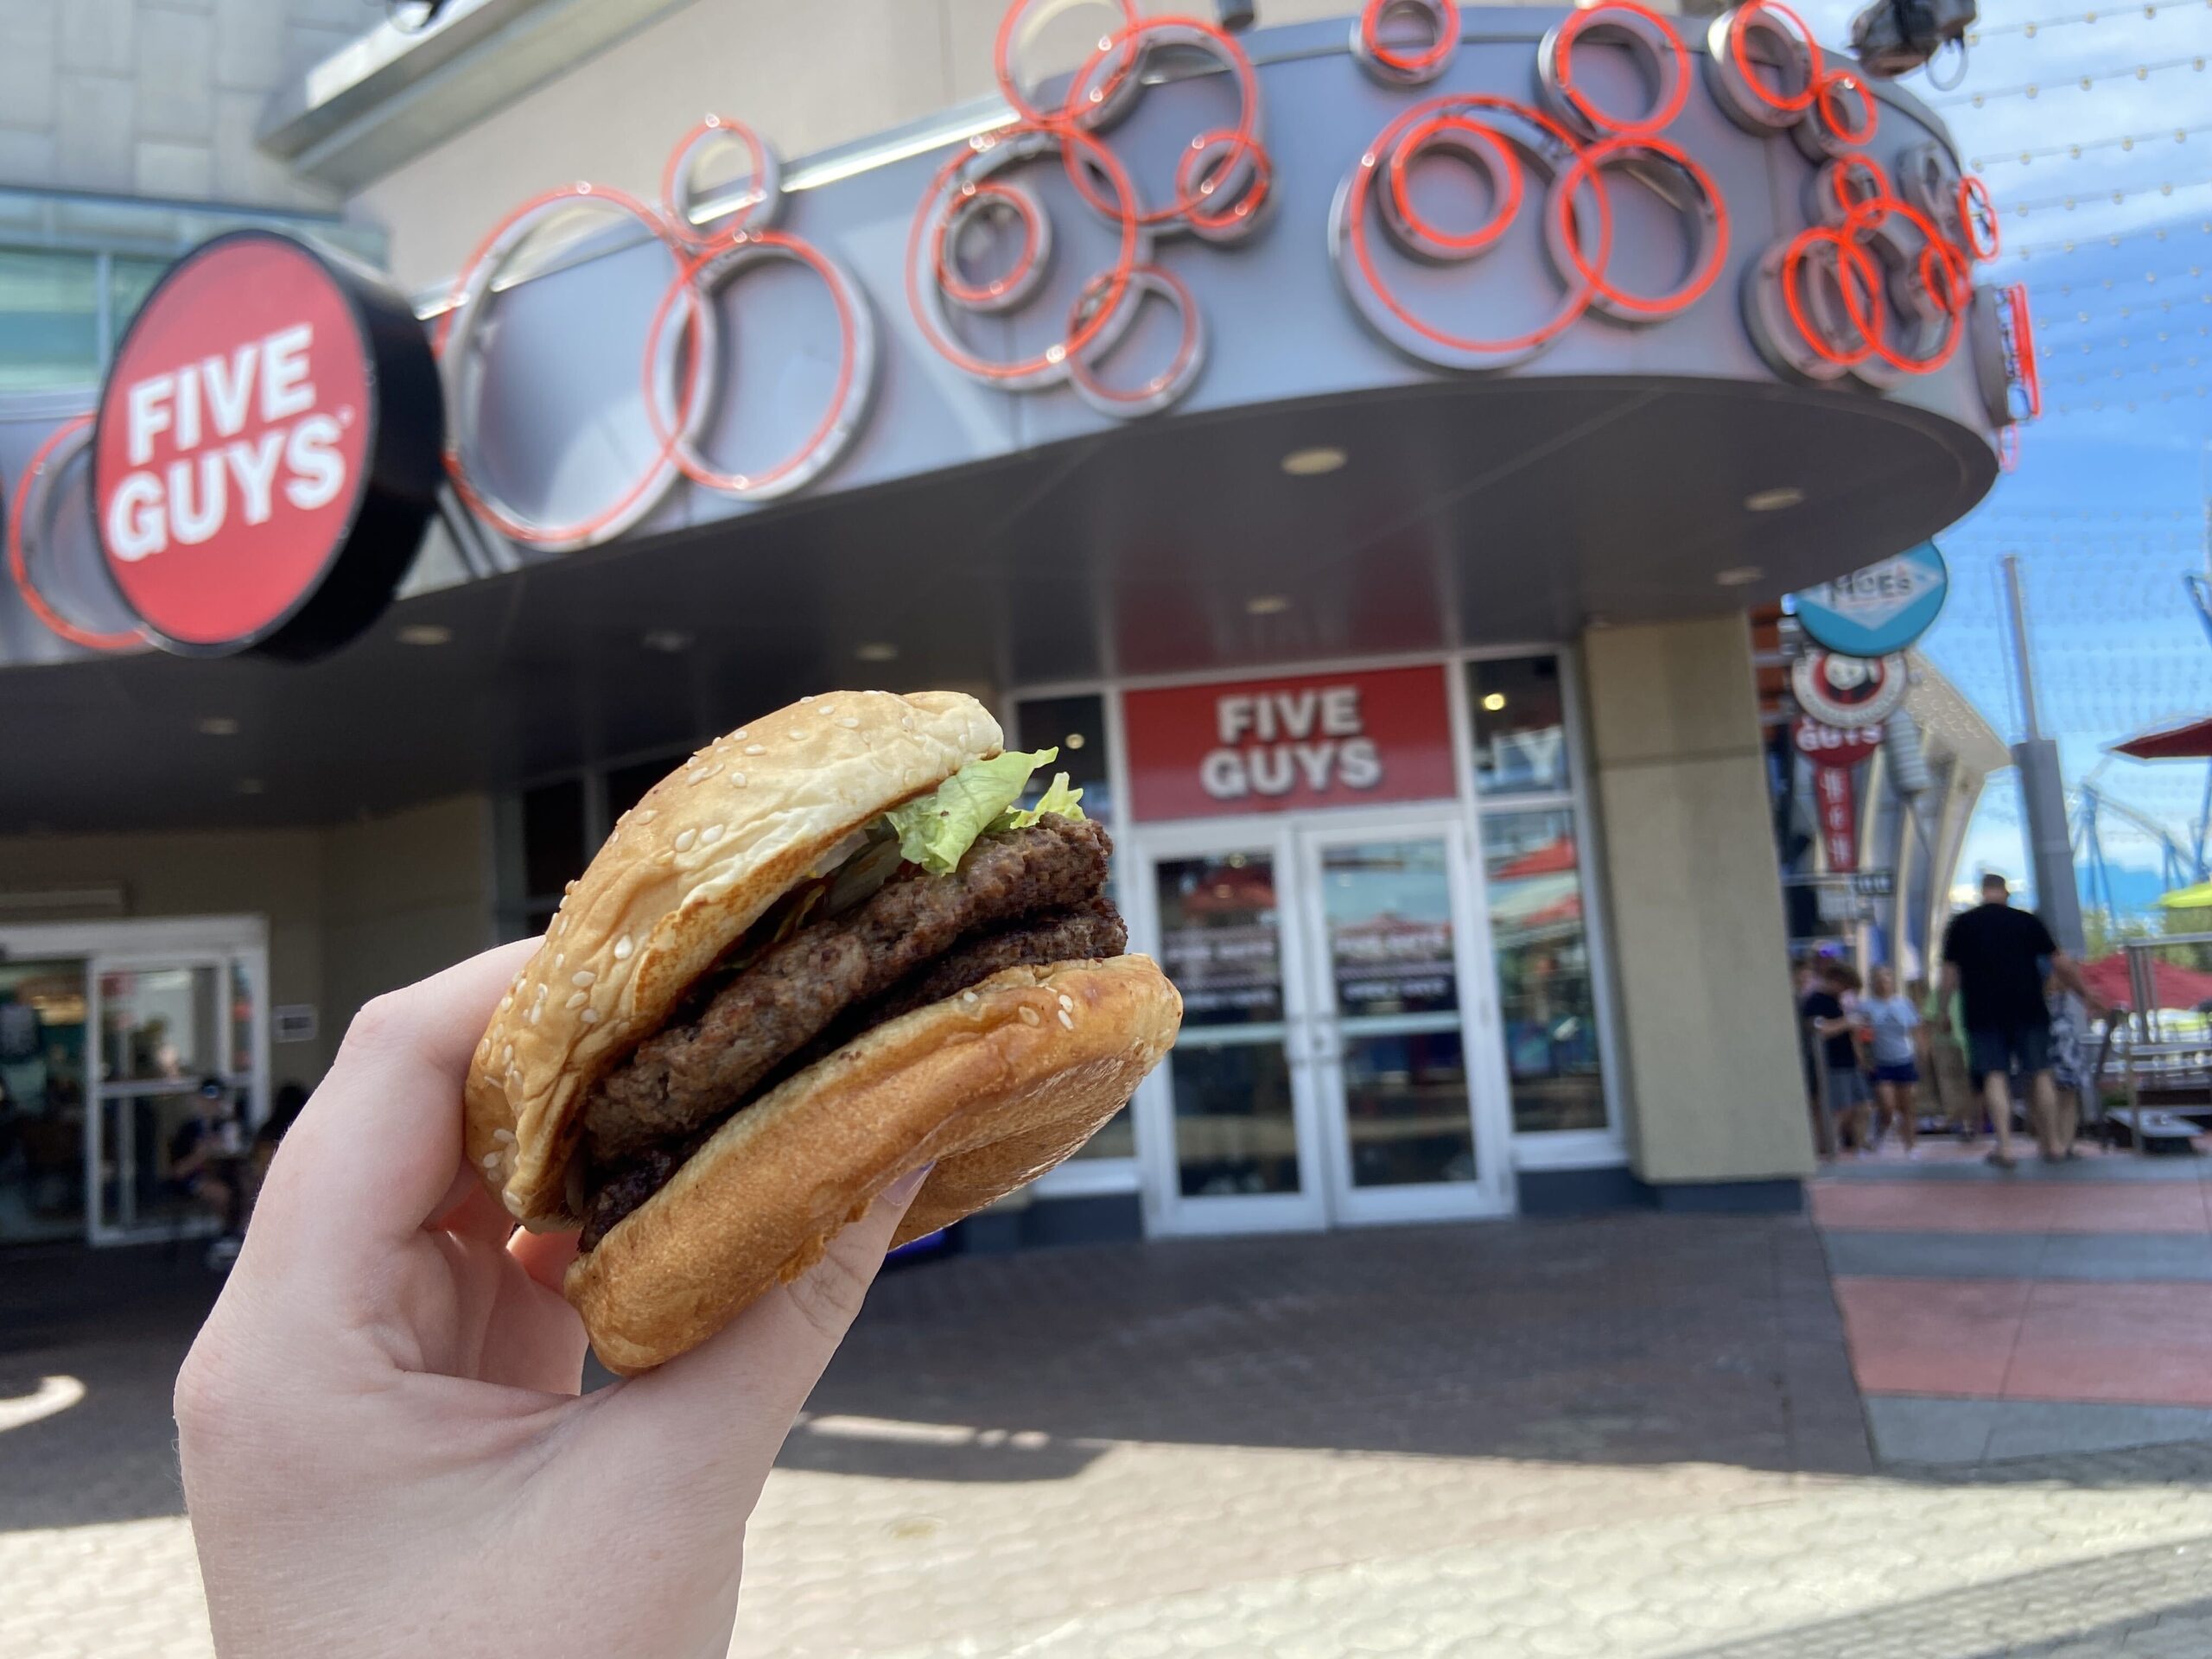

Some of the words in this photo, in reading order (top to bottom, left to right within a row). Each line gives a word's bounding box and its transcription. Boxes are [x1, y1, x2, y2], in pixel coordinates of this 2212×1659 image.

[128, 321, 316, 467] FIVE
[108, 414, 346, 562] GUYS
[1217, 684, 1363, 745] FIVE
[1201, 737, 1382, 798] GUYS
